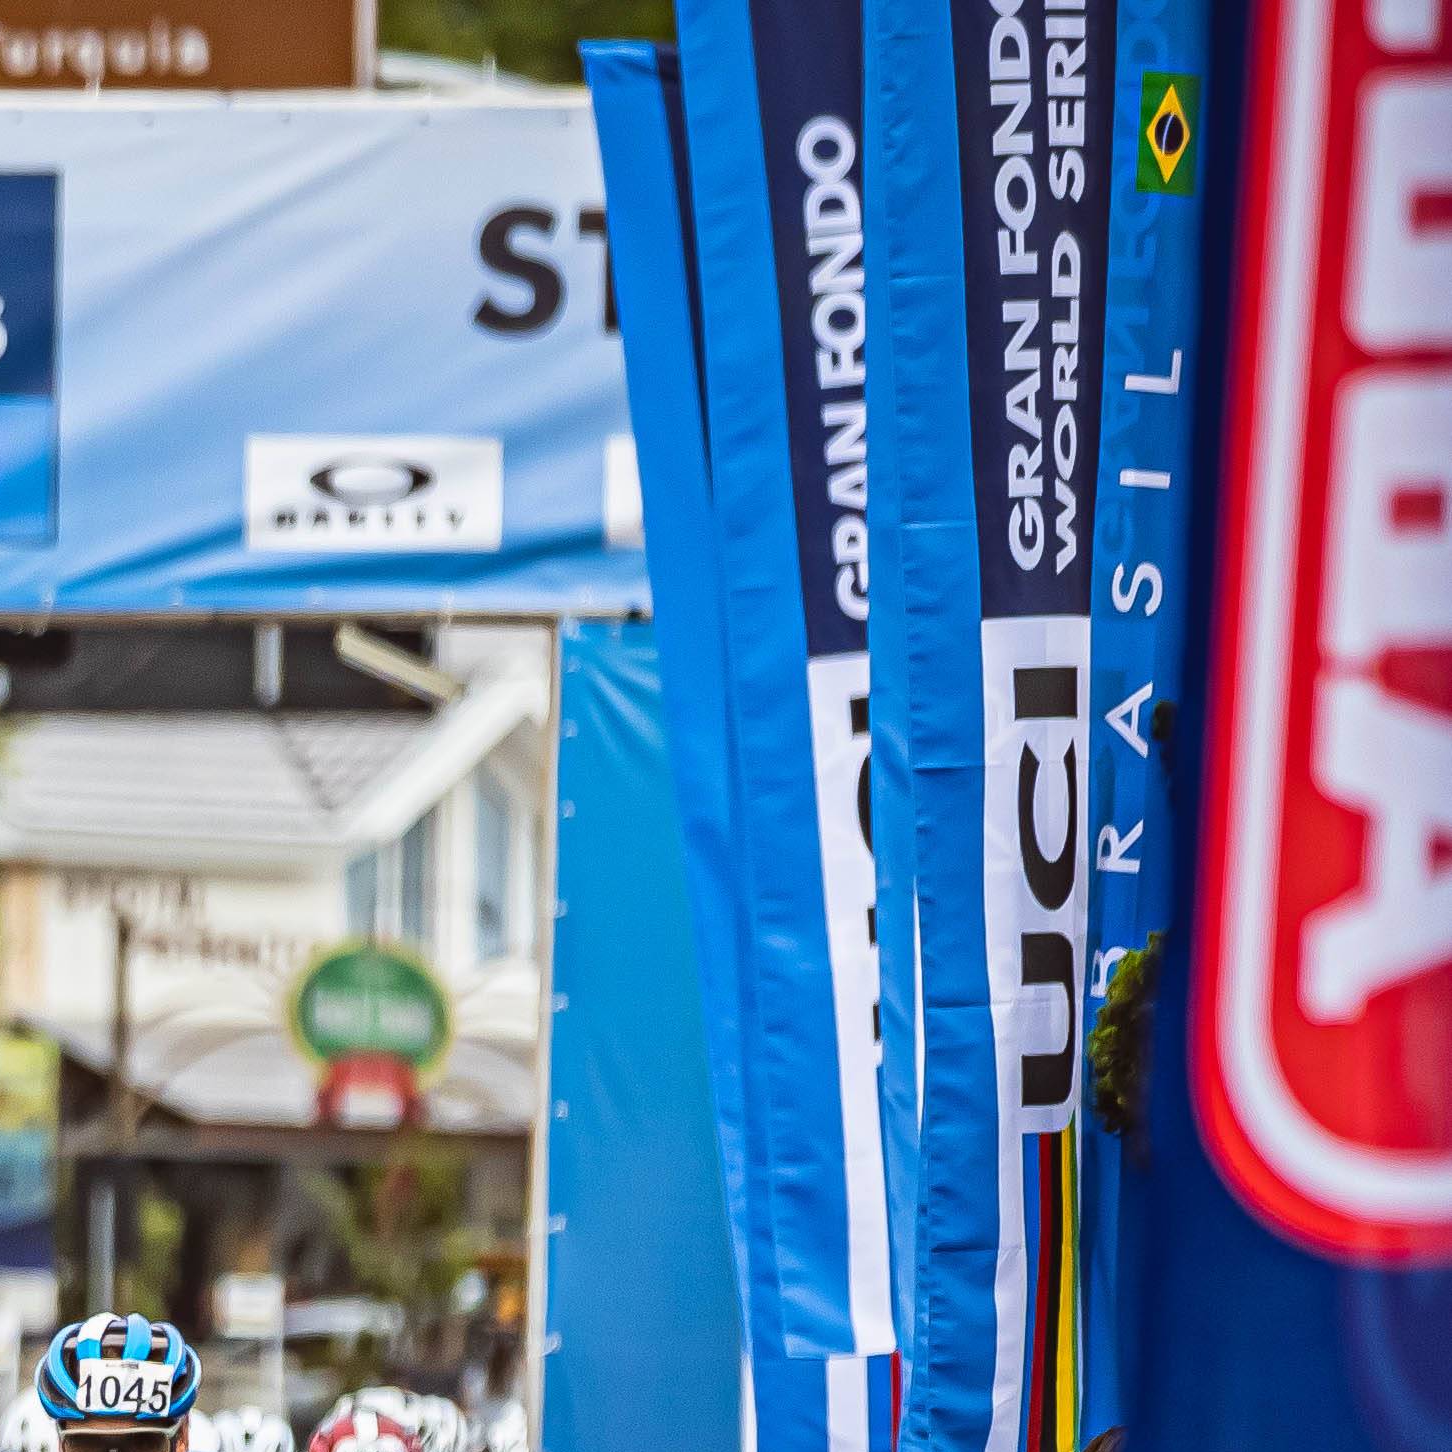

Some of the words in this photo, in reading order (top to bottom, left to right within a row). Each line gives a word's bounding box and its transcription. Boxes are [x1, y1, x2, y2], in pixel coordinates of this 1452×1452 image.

[989, 0, 1038, 275] FOND
[1045, 0, 1086, 204] SERI
[797, 114, 866, 389] FONDO
[1009, 299, 1045, 571] GRAN
[1052, 229, 1081, 575] WORLD
[1013, 667, 1078, 1108] UCI
[80, 1375, 170, 1414] 1045
